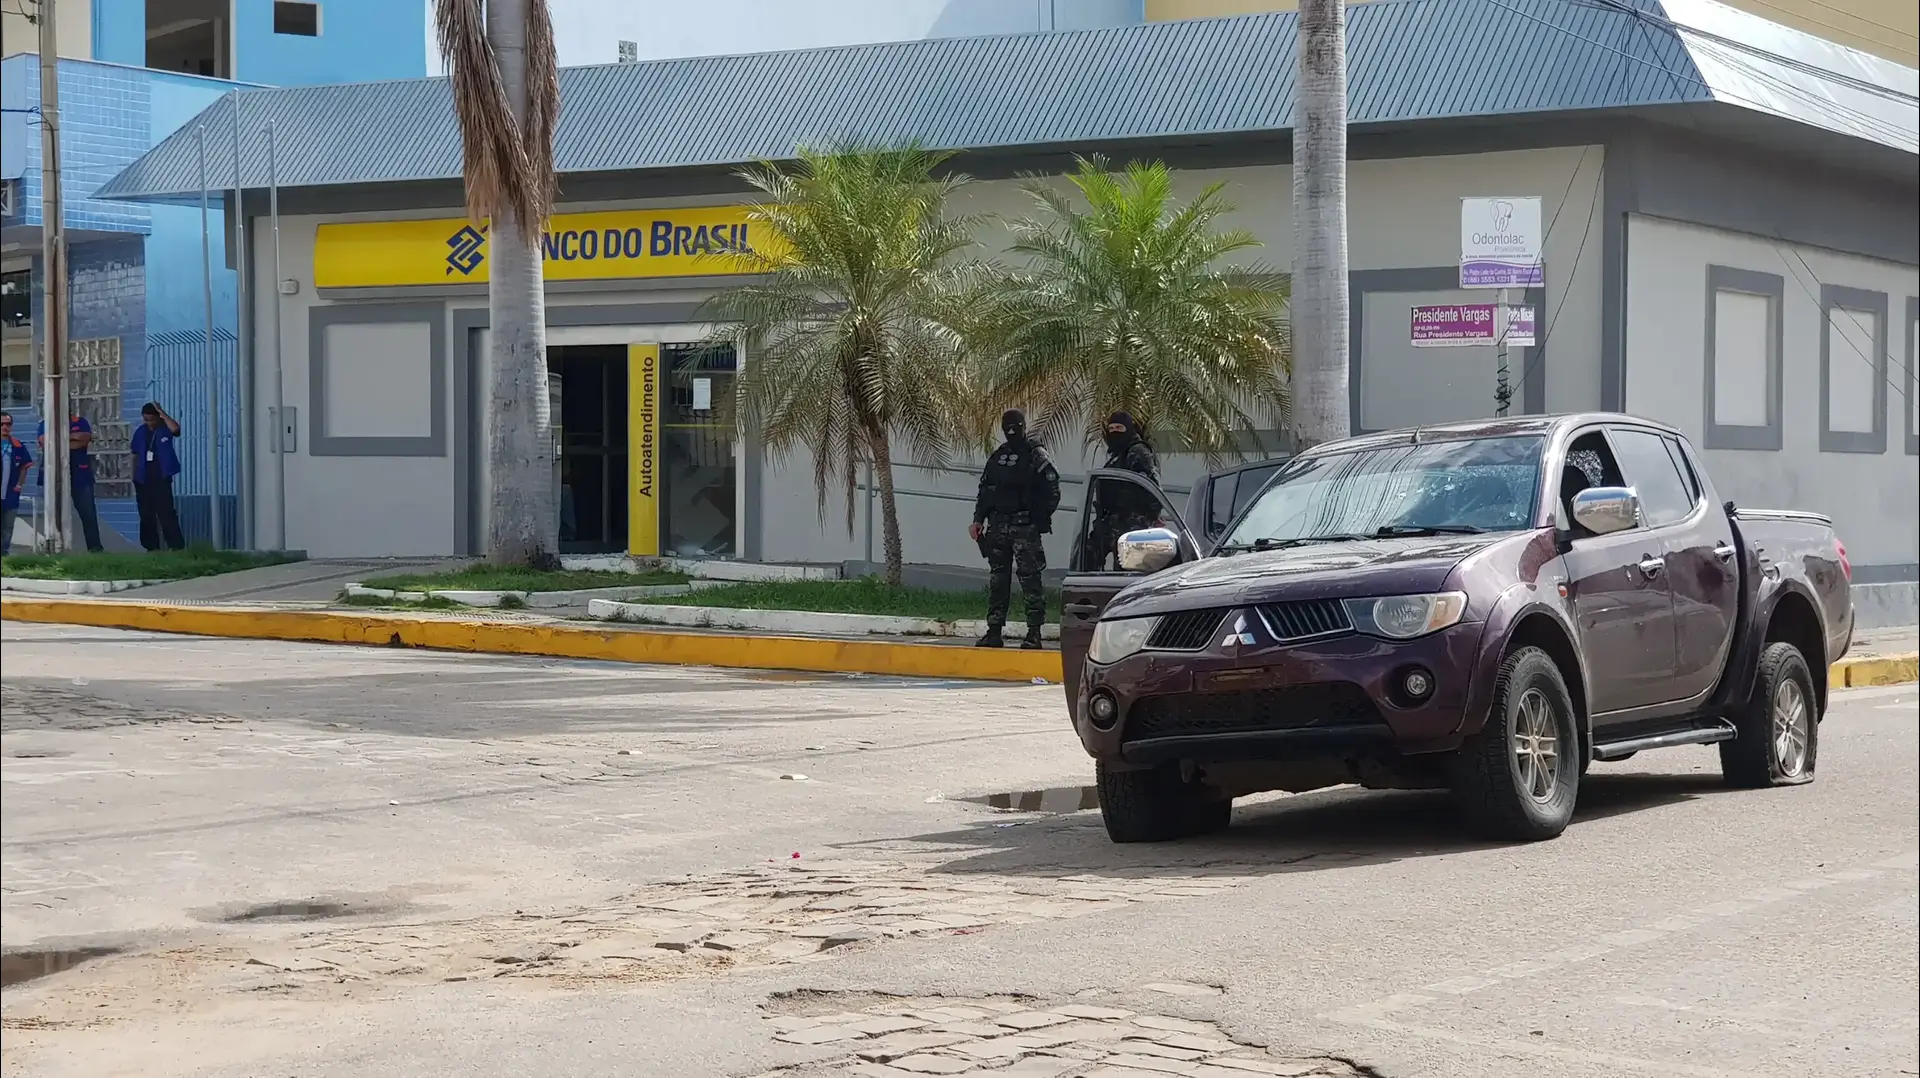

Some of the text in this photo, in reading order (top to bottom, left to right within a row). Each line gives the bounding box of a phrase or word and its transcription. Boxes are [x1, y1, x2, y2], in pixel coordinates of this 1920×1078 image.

[542, 228, 598, 261] NCO
[603, 228, 642, 259] DO
[1472, 232, 1524, 245] Odontolac
[1413, 307, 1490, 325] Presidente Vargas
[1465, 330, 1488, 338] Vargas
[639, 356, 655, 497] Autoatendimento
